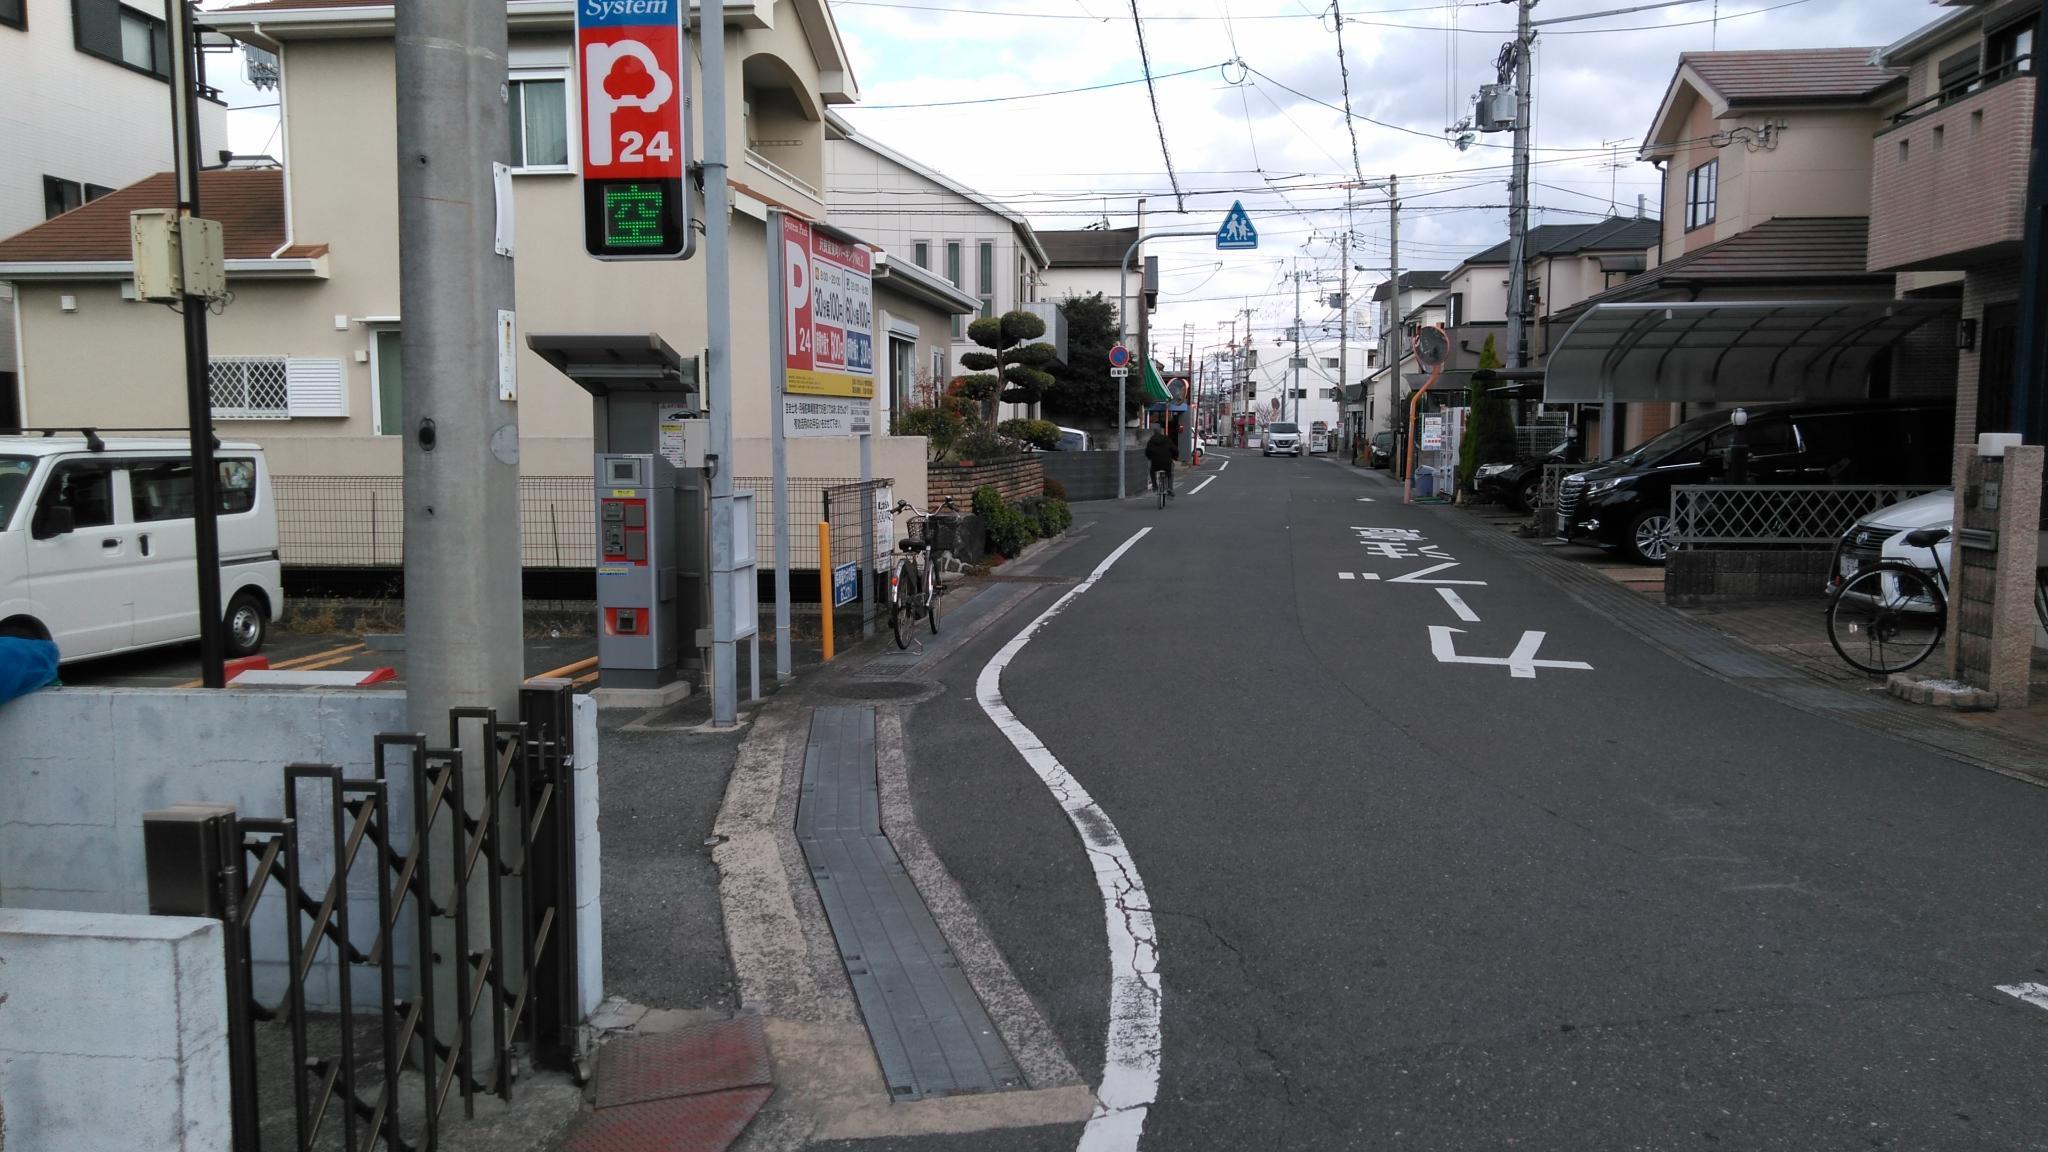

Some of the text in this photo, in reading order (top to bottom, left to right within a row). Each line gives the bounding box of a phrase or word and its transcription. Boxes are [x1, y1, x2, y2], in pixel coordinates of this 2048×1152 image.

[585, 0, 668, 19] System
[619, 131, 674, 163] 24
[607, 184, 664, 245] 空
[799, 327, 812, 353] 24
